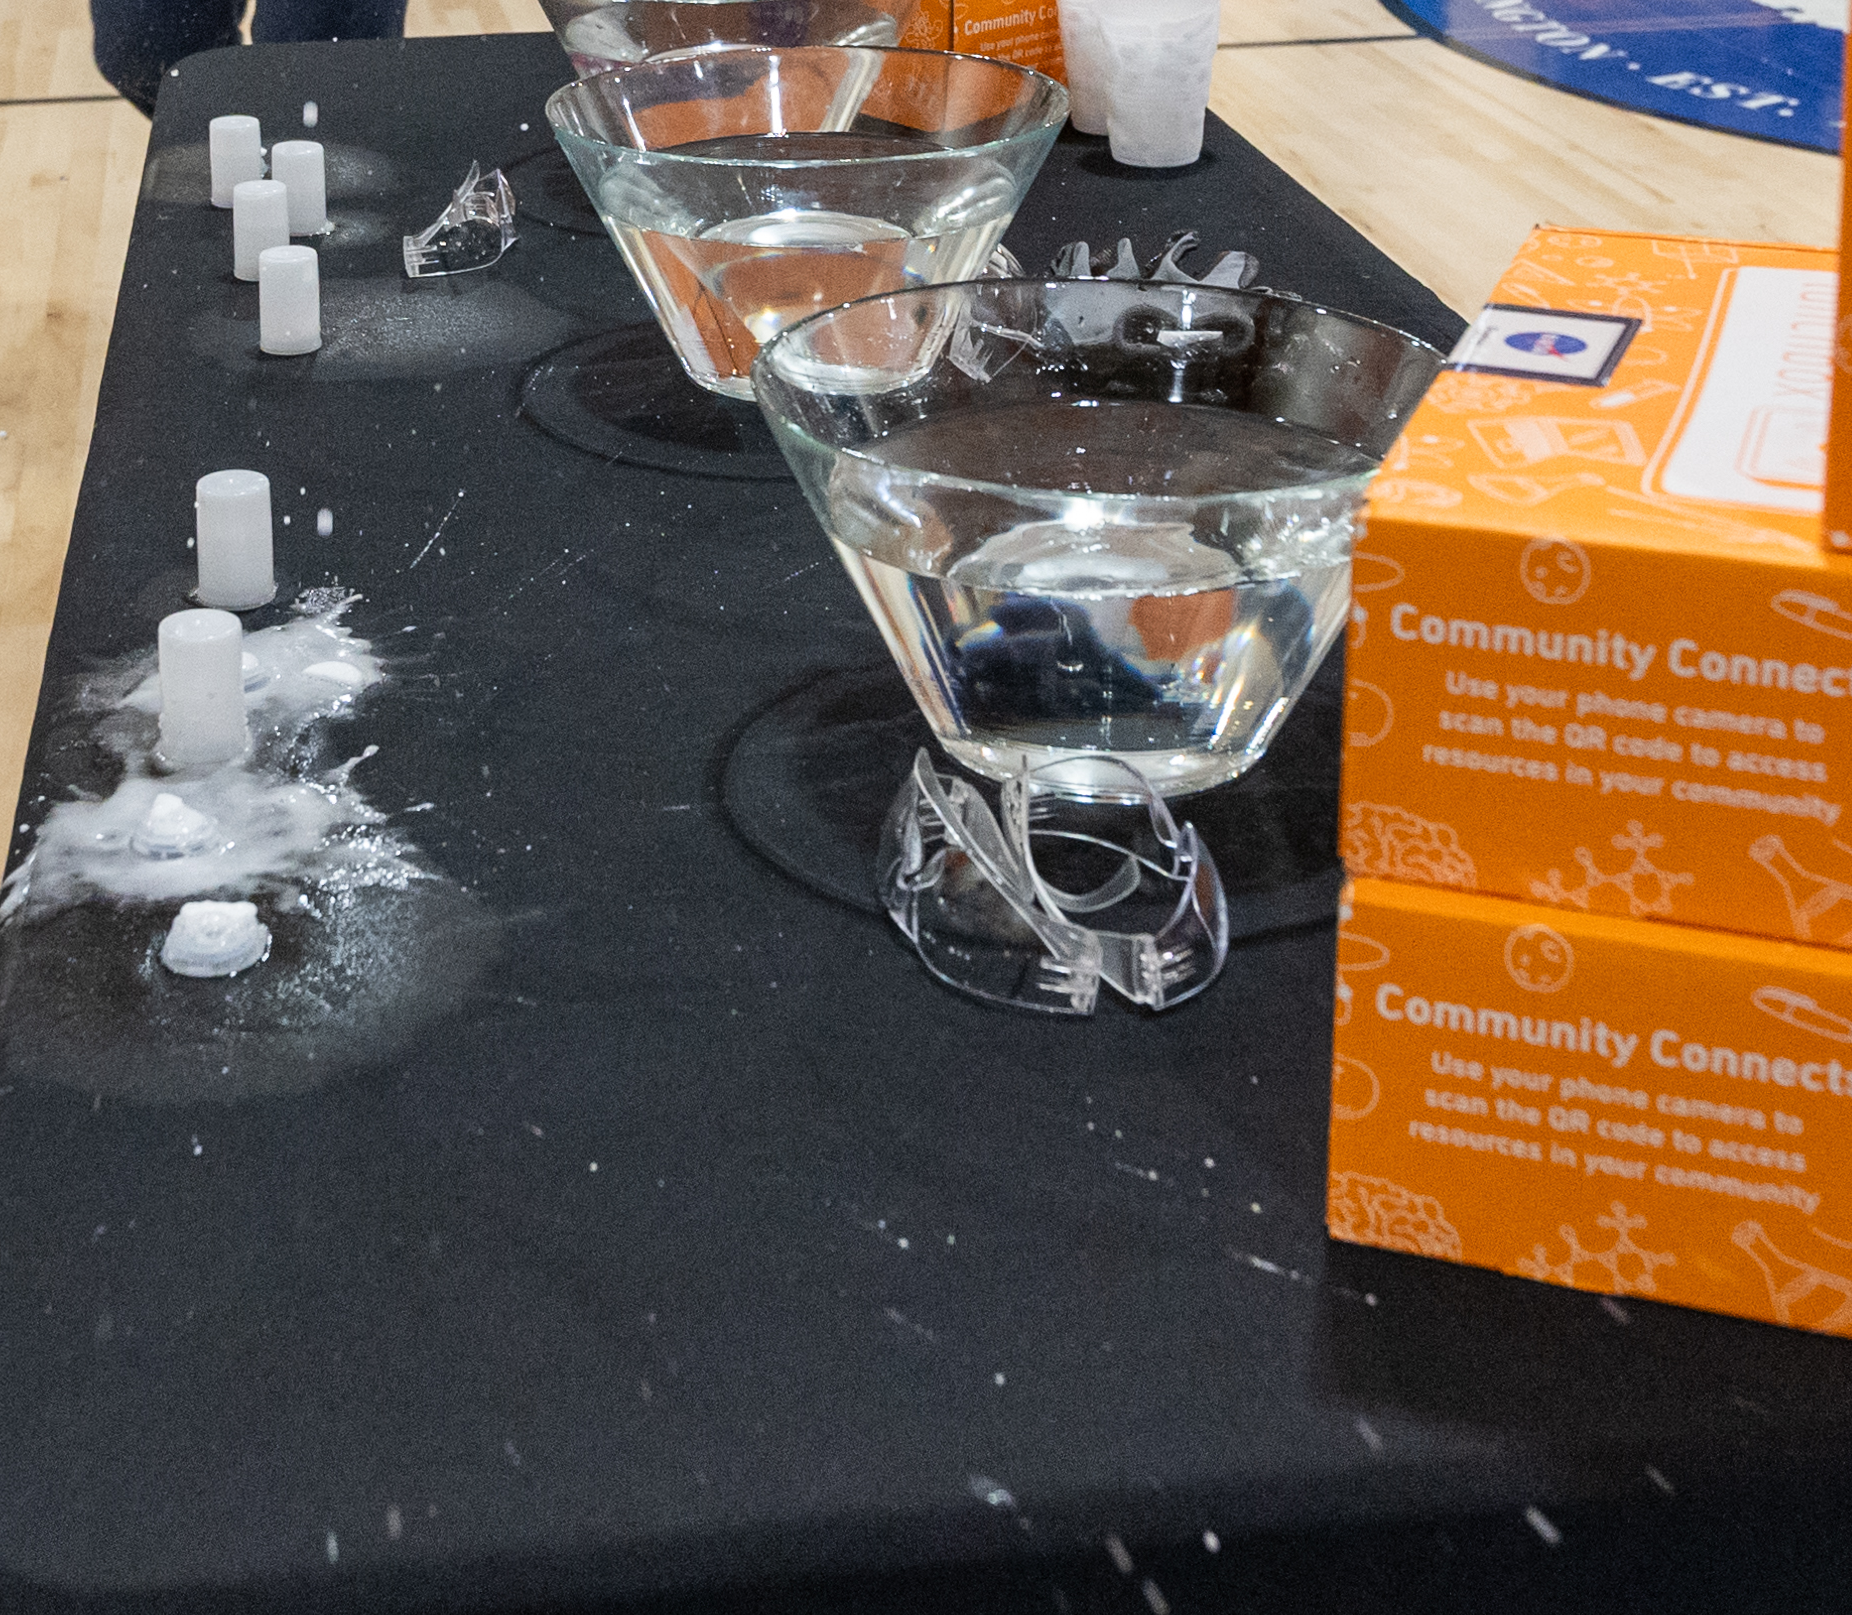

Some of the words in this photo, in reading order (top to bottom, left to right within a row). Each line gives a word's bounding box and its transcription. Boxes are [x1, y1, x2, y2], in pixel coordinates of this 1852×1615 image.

[964, 9, 1036, 36] Community
[996, 37, 1013, 51] your
[1014, 33, 1039, 46] phone
[1012, 48, 1024, 60] QR
[1646, 71, 1800, 118] EST.
[1390, 602, 1657, 681] Community
[1445, 670, 1499, 701] Use
[1505, 682, 1568, 709] your
[1575, 691, 1667, 724] phone
[1673, 705, 1787, 740] camera
[1793, 718, 1825, 744] to
[1438, 709, 1504, 736] scan
[1510, 716, 1558, 745] the
[1563, 722, 1608, 752] QR
[1612, 731, 1684, 763] code
[1689, 743, 1721, 768] to
[1726, 750, 1828, 783] access
[1422, 744, 1559, 783] resources
[1564, 759, 1594, 786] in
[1599, 770, 1665, 795] your
[1671, 779, 1842, 827] community
[1375, 982, 1638, 1068] Community
[1424, 1087, 1489, 1116] scan
[1494, 1097, 1542, 1126] the
[1548, 1105, 1591, 1135] QR
[1596, 1117, 1665, 1149] code
[1671, 1128, 1703, 1155] to
[1707, 1138, 1808, 1174] access
[1431, 1050, 1484, 1081] Use
[1491, 1064, 1553, 1090] your
[1559, 1073, 1649, 1111] phone
[1655, 1092, 1767, 1131] camera
[1772, 1110, 1805, 1136] to
[1408, 1120, 1543, 1162] resources
[1549, 1141, 1578, 1168] in
[1583, 1152, 1647, 1181] your
[1654, 1164, 1822, 1215] community
